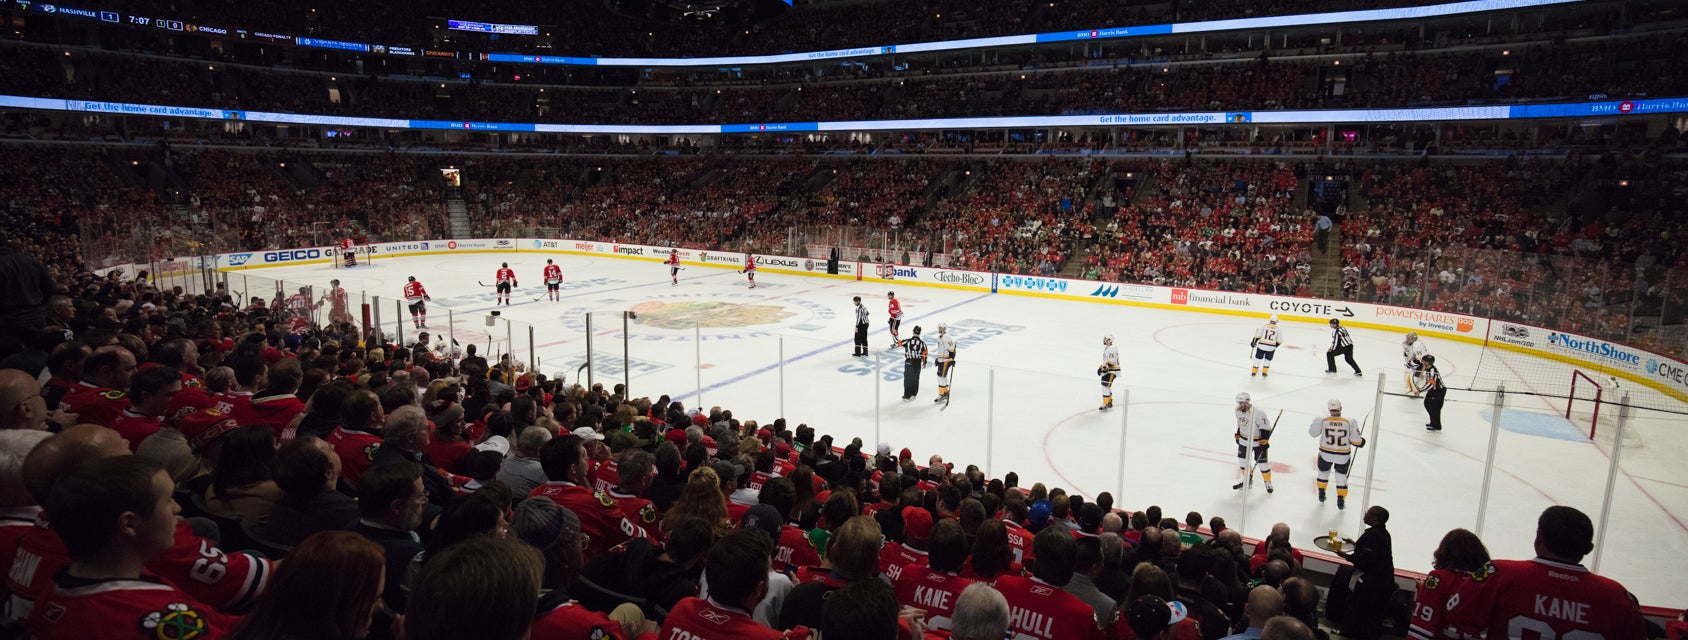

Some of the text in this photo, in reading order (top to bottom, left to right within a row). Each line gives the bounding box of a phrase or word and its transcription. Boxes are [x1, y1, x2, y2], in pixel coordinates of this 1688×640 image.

[59, 8, 97, 17] NASHVILLE
[129, 15, 150, 25] 7:07
[199, 26, 228, 35] CHICAGO
[85, 102, 100, 110] Get
[103, 102, 119, 111] the
[121, 104, 147, 112] home
[149, 105, 167, 113] card
[1636, 102, 1670, 110] Harris
[1099, 115, 1113, 123] Get
[1128, 114, 1151, 122] home
[1152, 114, 1170, 122] card
[385, 244, 419, 252] UNITED
[543, 241, 558, 249] AT&T
[575, 242, 594, 252] meijer
[618, 245, 643, 255] impact
[229, 255, 249, 266] SAP
[264, 249, 320, 263] GEICO
[707, 255, 740, 263] DRAFTKINGS
[764, 258, 798, 267] LEXUS
[501, 271, 508, 279] 2
[548, 270, 557, 278] 14
[893, 268, 917, 278] bank
[939, 271, 979, 284] Techo-Bloc
[406, 285, 414, 296] 15
[1172, 292, 1251, 307] mb financial bank
[1270, 300, 1331, 315] COYOTE
[1264, 330, 1276, 341] 12
[1558, 333, 1640, 364] NorthShore
[1659, 363, 1682, 384] CME
[1324, 428, 1347, 446] 52
[620, 517, 634, 536] 8
[1008, 535, 1024, 547] SSA
[190, 539, 229, 584] 65
[1548, 571, 1580, 582] Reebok
[914, 585, 952, 611] KANE
[1447, 593, 1460, 611] 8
[1412, 602, 1434, 622] 19
[1535, 594, 1591, 624] KANE
[1011, 606, 1053, 639] HULL
